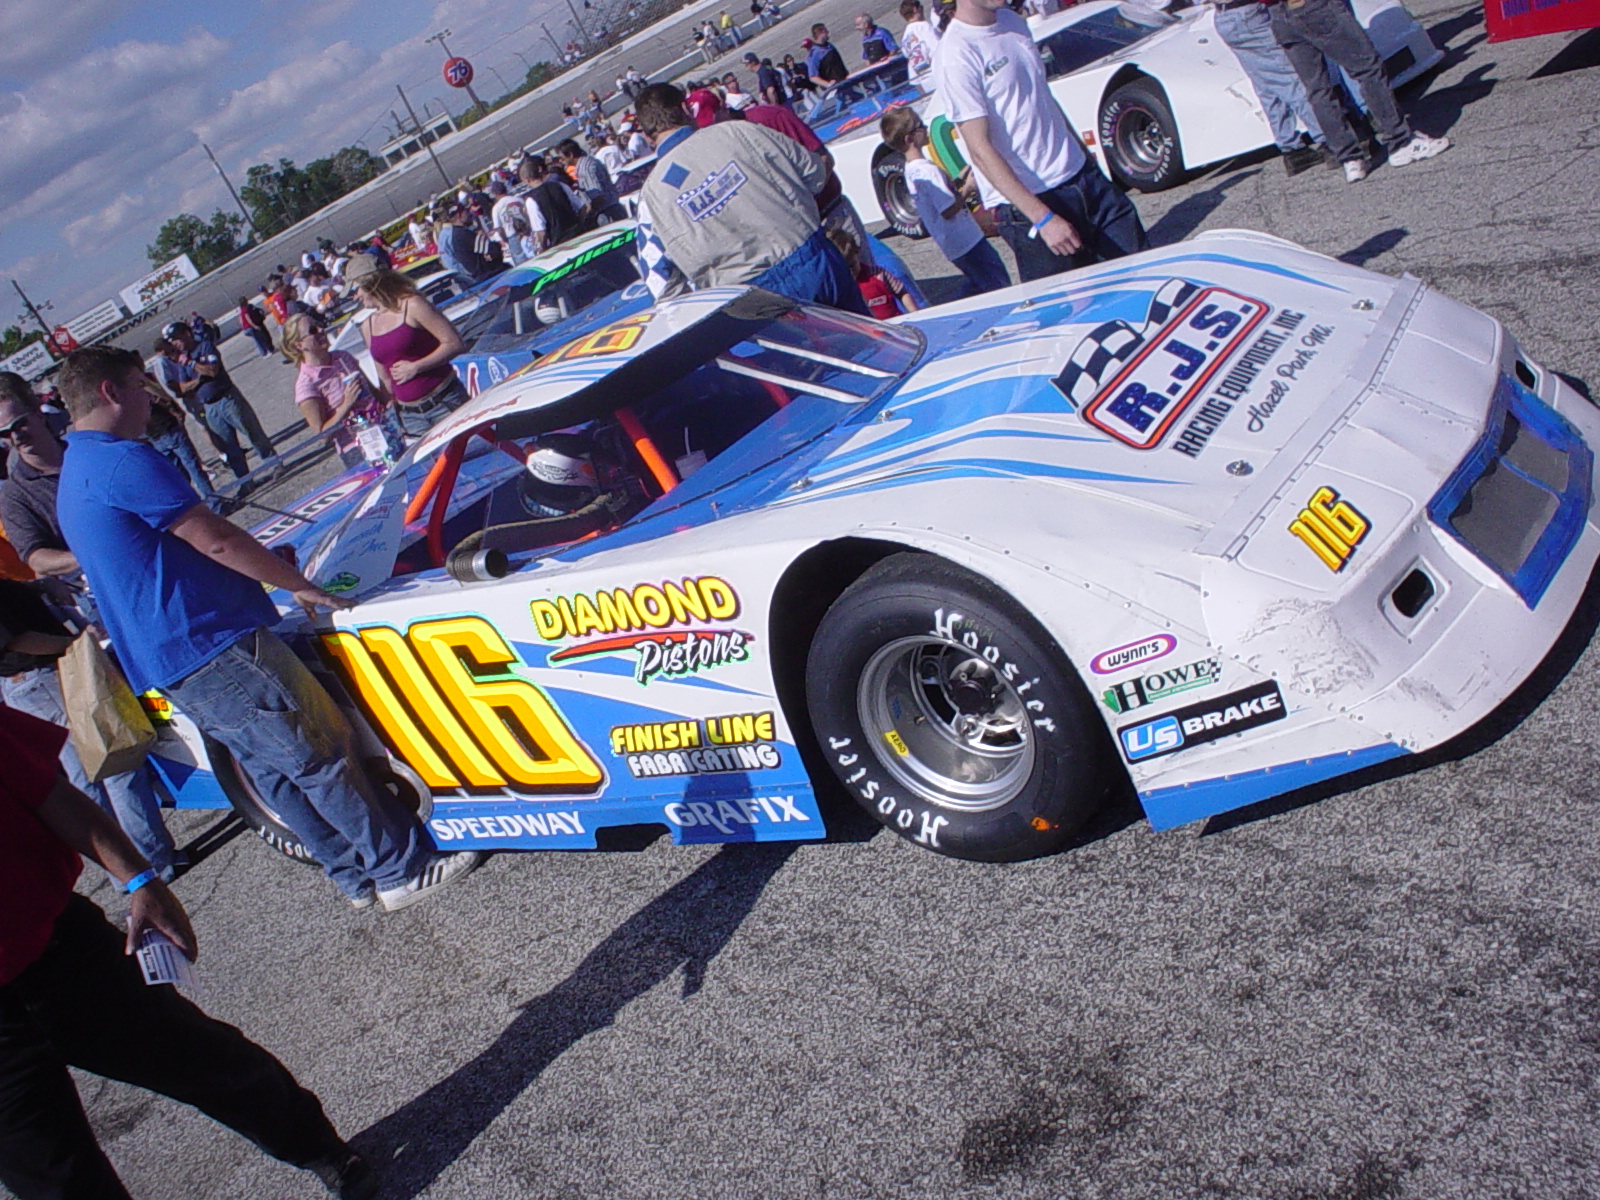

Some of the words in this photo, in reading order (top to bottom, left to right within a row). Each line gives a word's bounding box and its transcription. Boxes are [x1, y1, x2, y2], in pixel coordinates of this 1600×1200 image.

[448, 60, 469, 84] 76
[1105, 303, 1254, 434] R.J.S.
[1172, 397, 1235, 459] RACING
[1271, 308, 1307, 337] INC
[1247, 379, 1290, 433] Hazel
[1287, 485, 1373, 574] 116
[530, 575, 740, 641] DIAMOND
[635, 629, 748, 685] Pistons
[929, 607, 1056, 733] Hoosier
[1108, 657, 1212, 716] HOWE
[317, 615, 605, 796] 116
[610, 720, 699, 756] FINISH
[705, 712, 777, 747] LINE
[1127, 723, 1180, 753] US
[1181, 692, 1282, 736] BRAKE
[627, 744, 781, 778] FABRICATING
[664, 795, 811, 835] GRAFIX
[828, 735, 950, 848] Hoosier
[430, 810, 587, 841] SPEEDWAY
